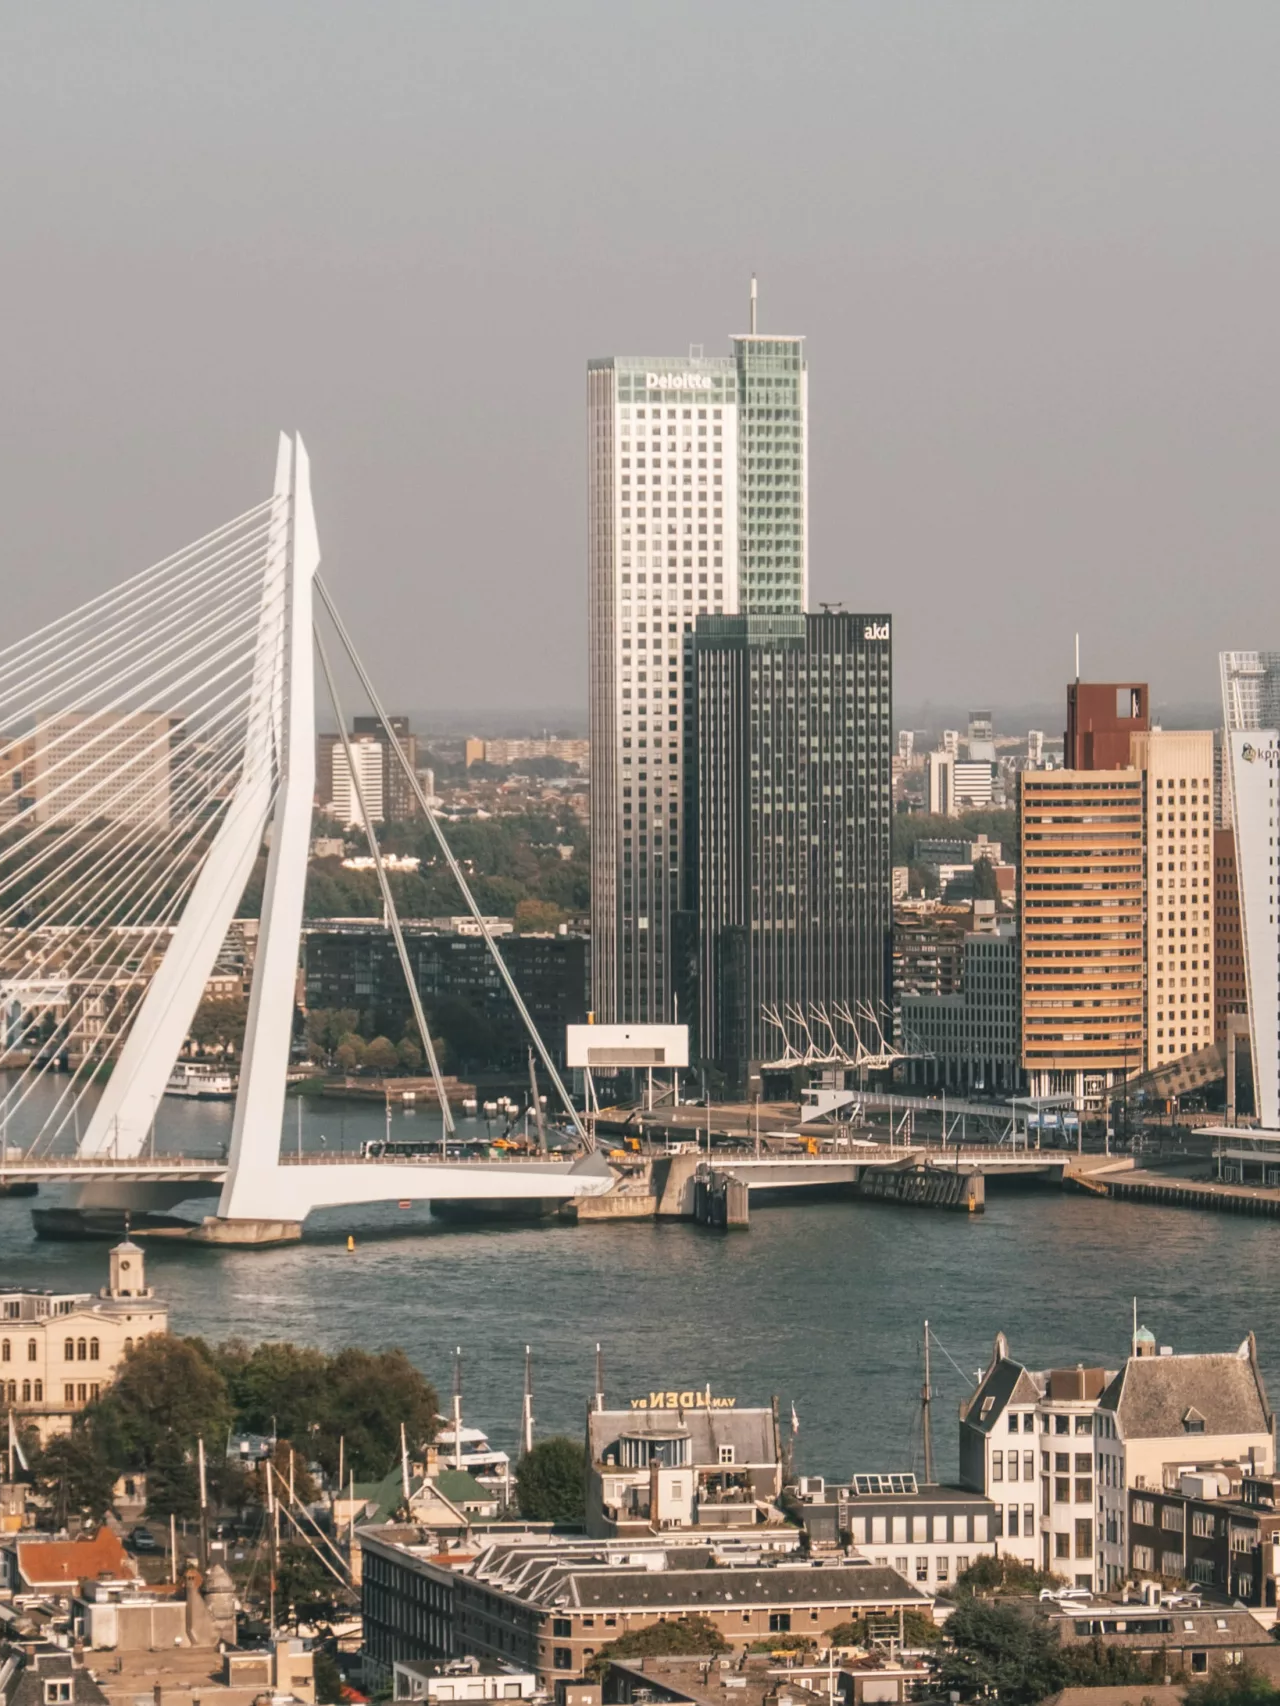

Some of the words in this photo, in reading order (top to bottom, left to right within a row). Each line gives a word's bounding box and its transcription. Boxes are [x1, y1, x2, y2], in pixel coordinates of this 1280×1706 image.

[646, 371, 712, 389] Deloitte
[864, 622, 890, 640] akd
[1257, 747, 1279, 762] kpn
